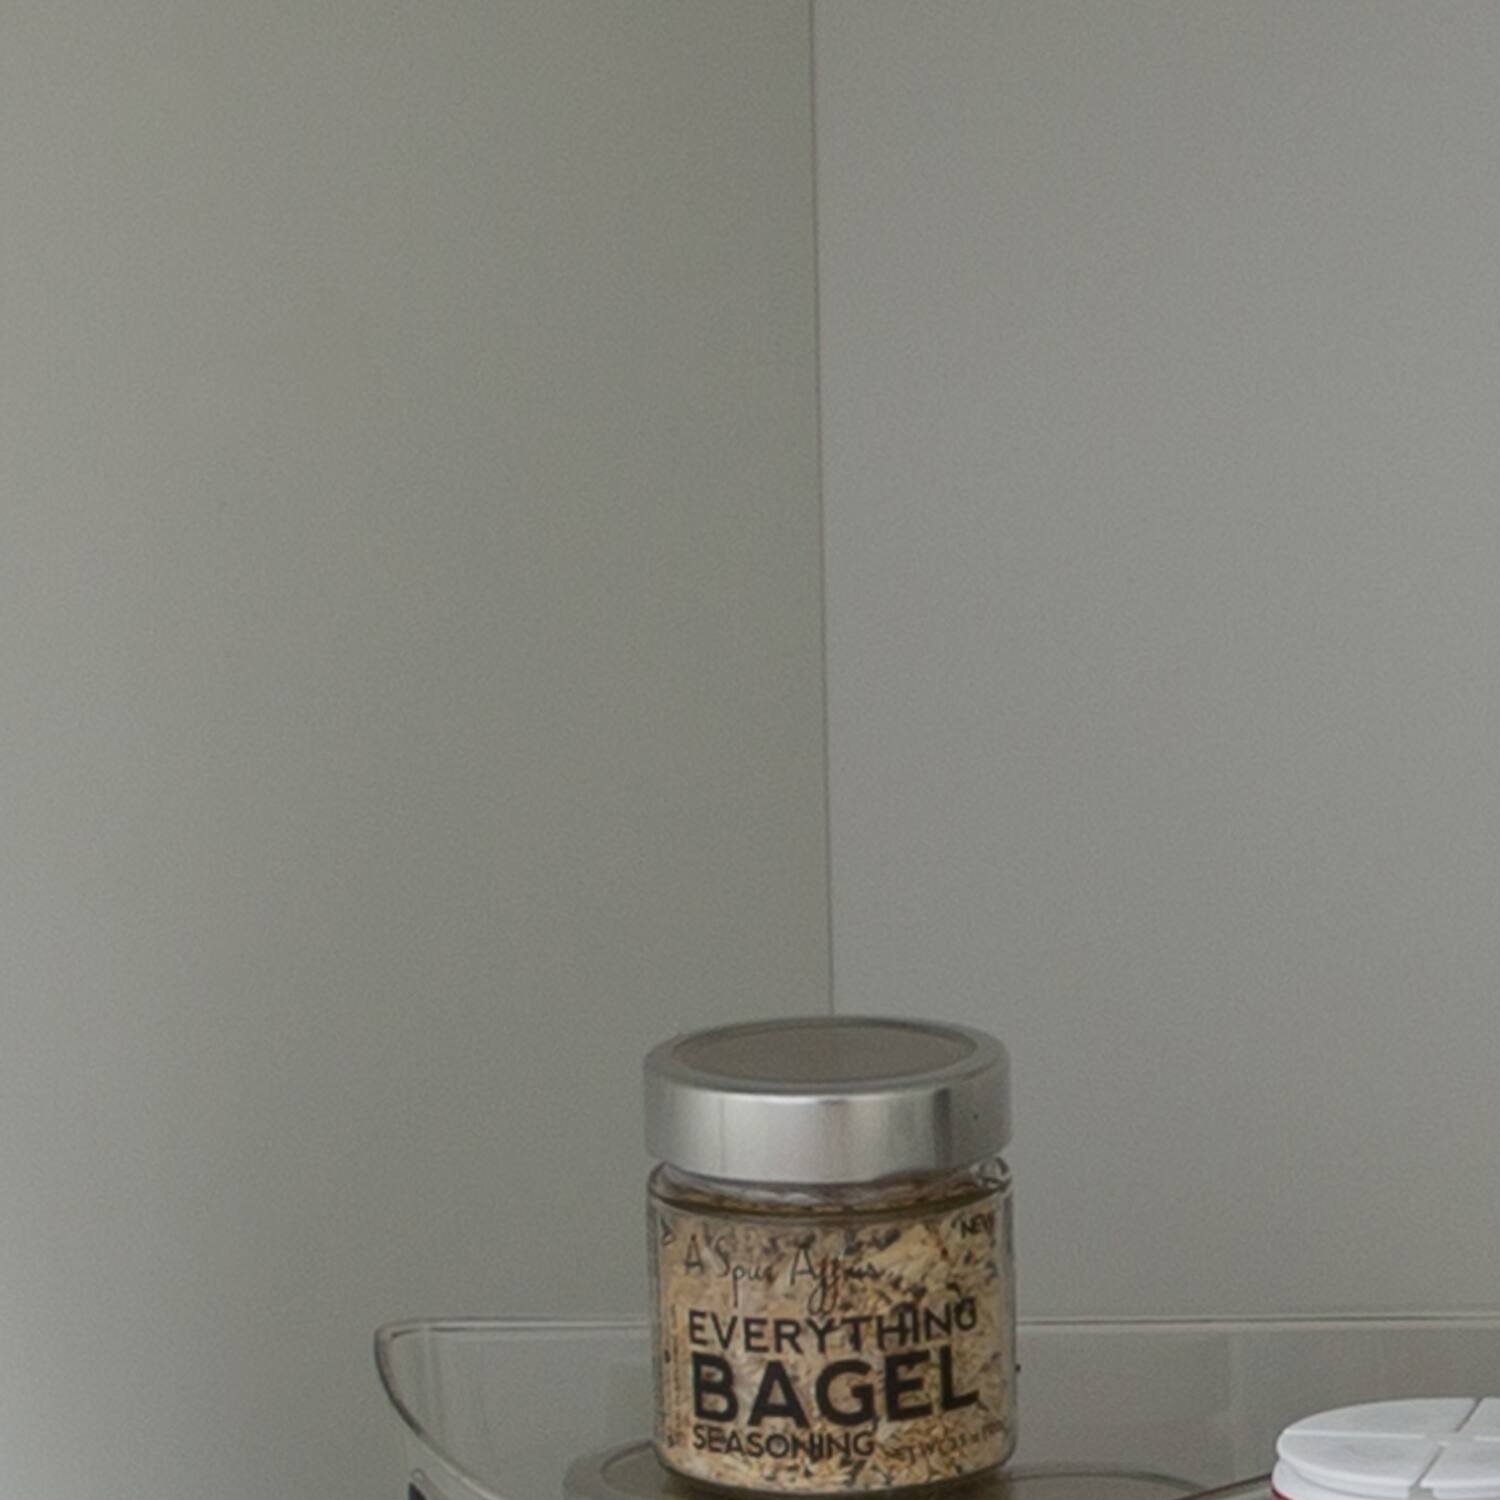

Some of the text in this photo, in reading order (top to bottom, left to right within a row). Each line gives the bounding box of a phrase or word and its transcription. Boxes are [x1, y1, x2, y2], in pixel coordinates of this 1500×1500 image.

[688, 1299, 976, 1353] EVERYTHING
[691, 1346, 980, 1429] BAGEL
[692, 1425, 875, 1461] SEASONING
